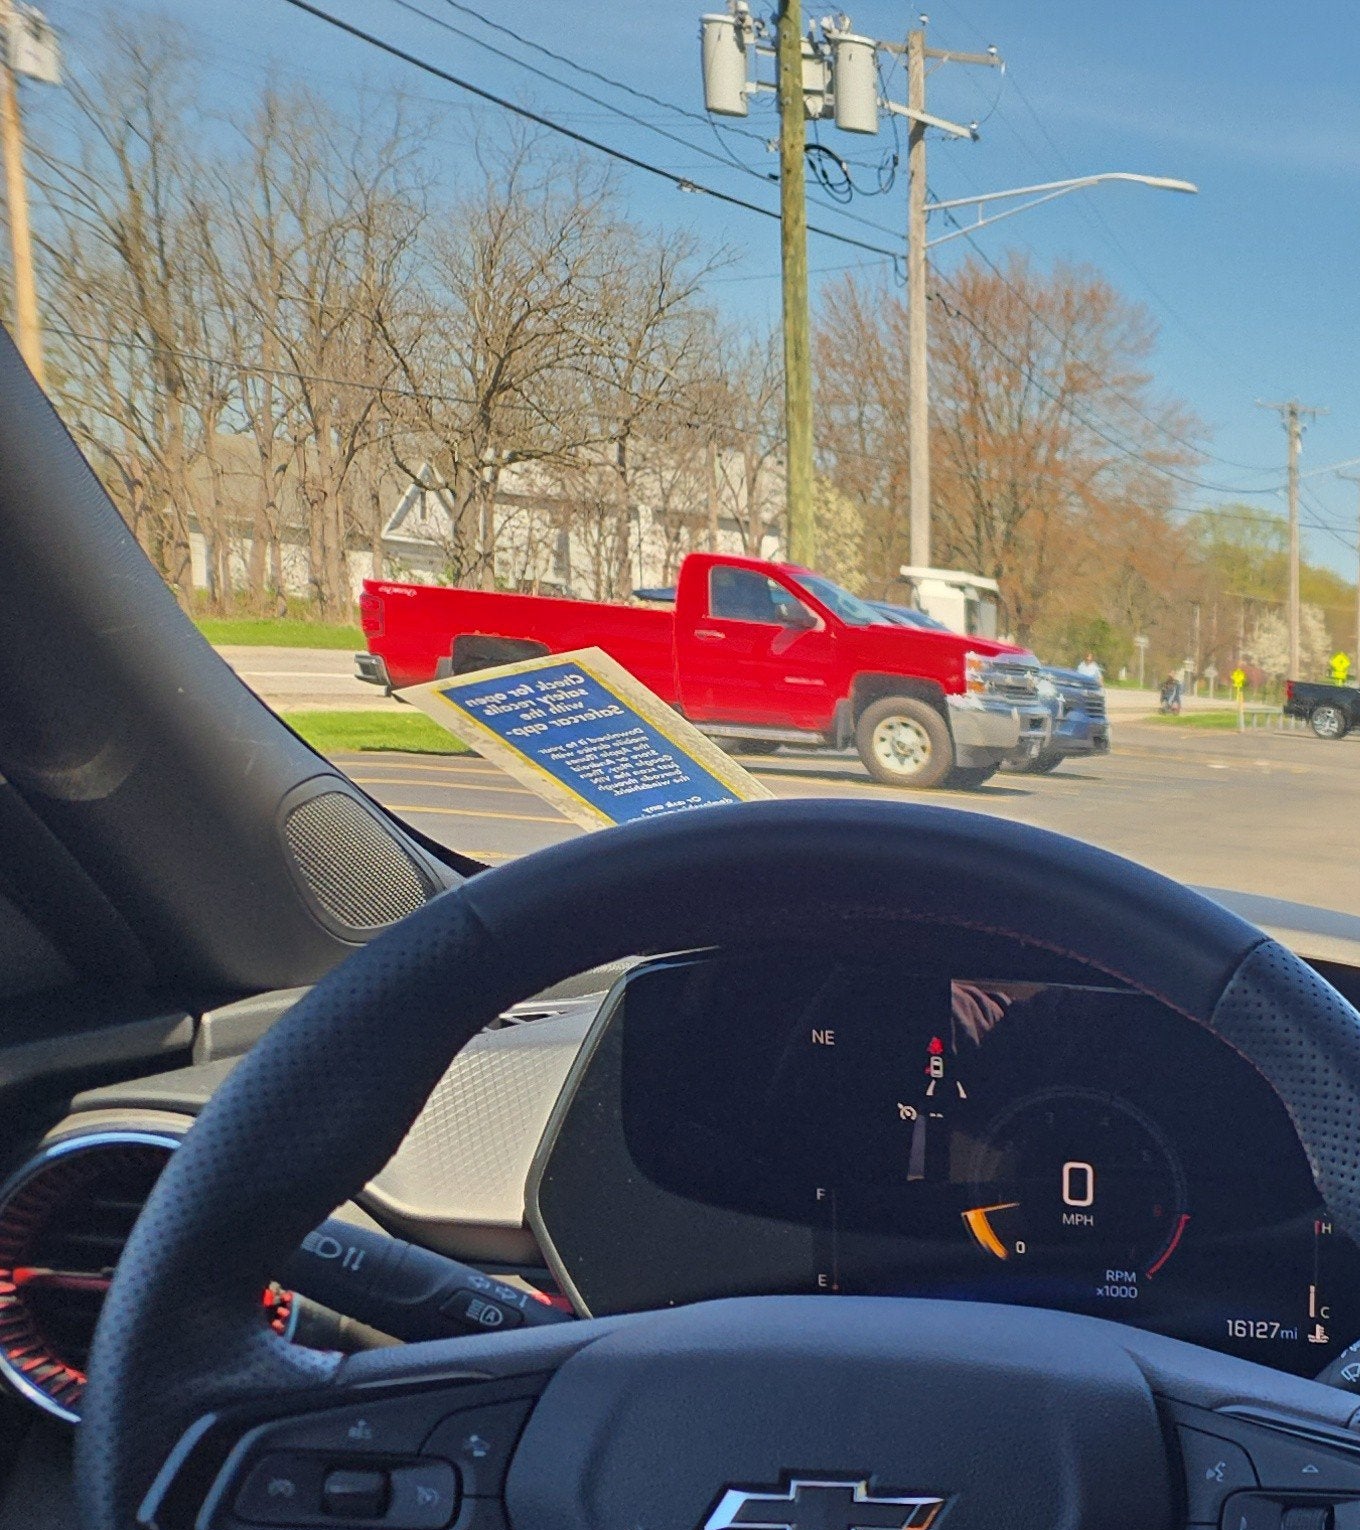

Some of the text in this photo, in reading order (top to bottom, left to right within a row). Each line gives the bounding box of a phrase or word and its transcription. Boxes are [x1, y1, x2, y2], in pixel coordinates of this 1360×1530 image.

[811, 1029, 836, 1046] NE
[1062, 1161, 1094, 1207] 0
[816, 1188, 826, 1200] F
[1062, 1213, 1094, 1226] MPH
[1321, 1222, 1332, 1234] H
[818, 1274, 828, 1287] E
[1106, 1270, 1137, 1283] RPM
[1097, 1285, 1138, 1299] x1000
[1320, 1306, 1330, 1319] C
